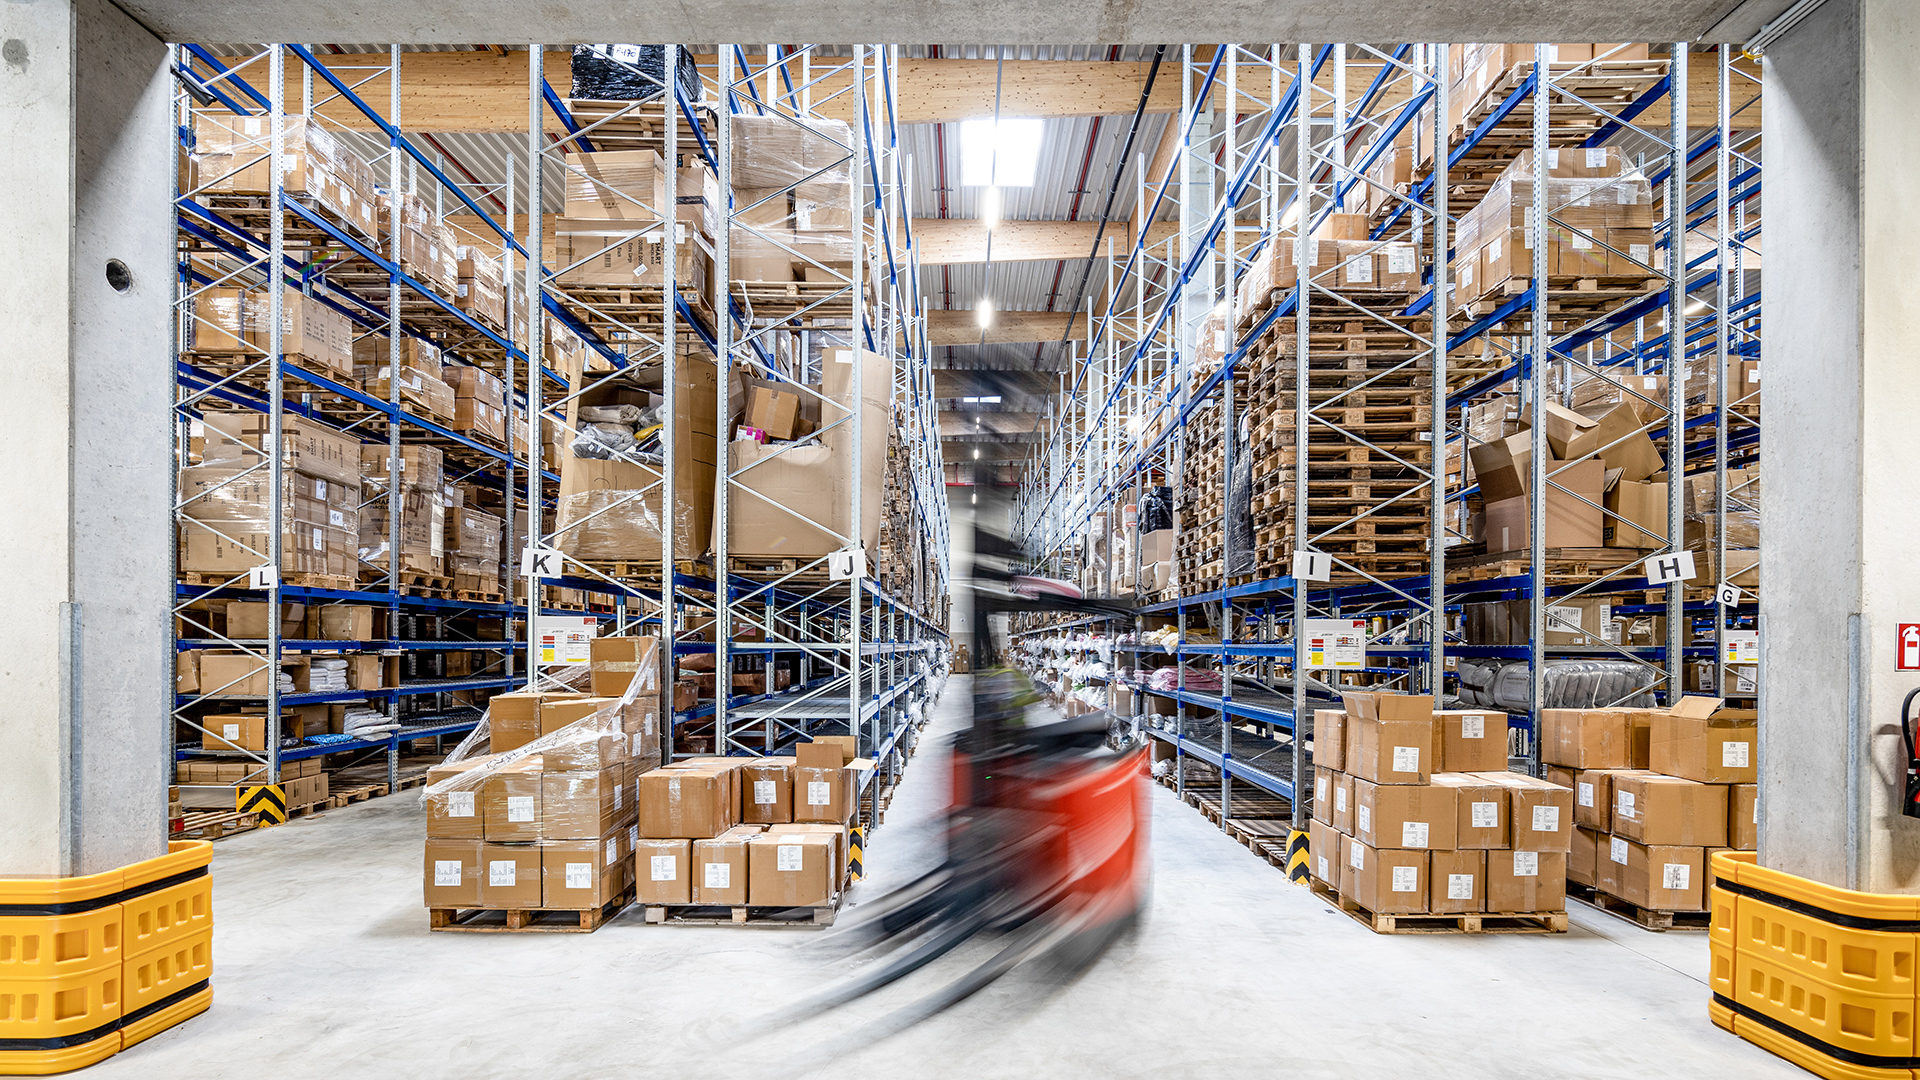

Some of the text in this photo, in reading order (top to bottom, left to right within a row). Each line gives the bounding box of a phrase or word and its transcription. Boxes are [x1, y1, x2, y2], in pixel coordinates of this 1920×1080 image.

[532, 553, 551, 575] K
[843, 556, 853, 575] J
[1309, 556, 1314, 575] I
[1658, 557, 1681, 580] H
[260, 571, 270, 586] L
[1722, 589, 1733, 603] G
